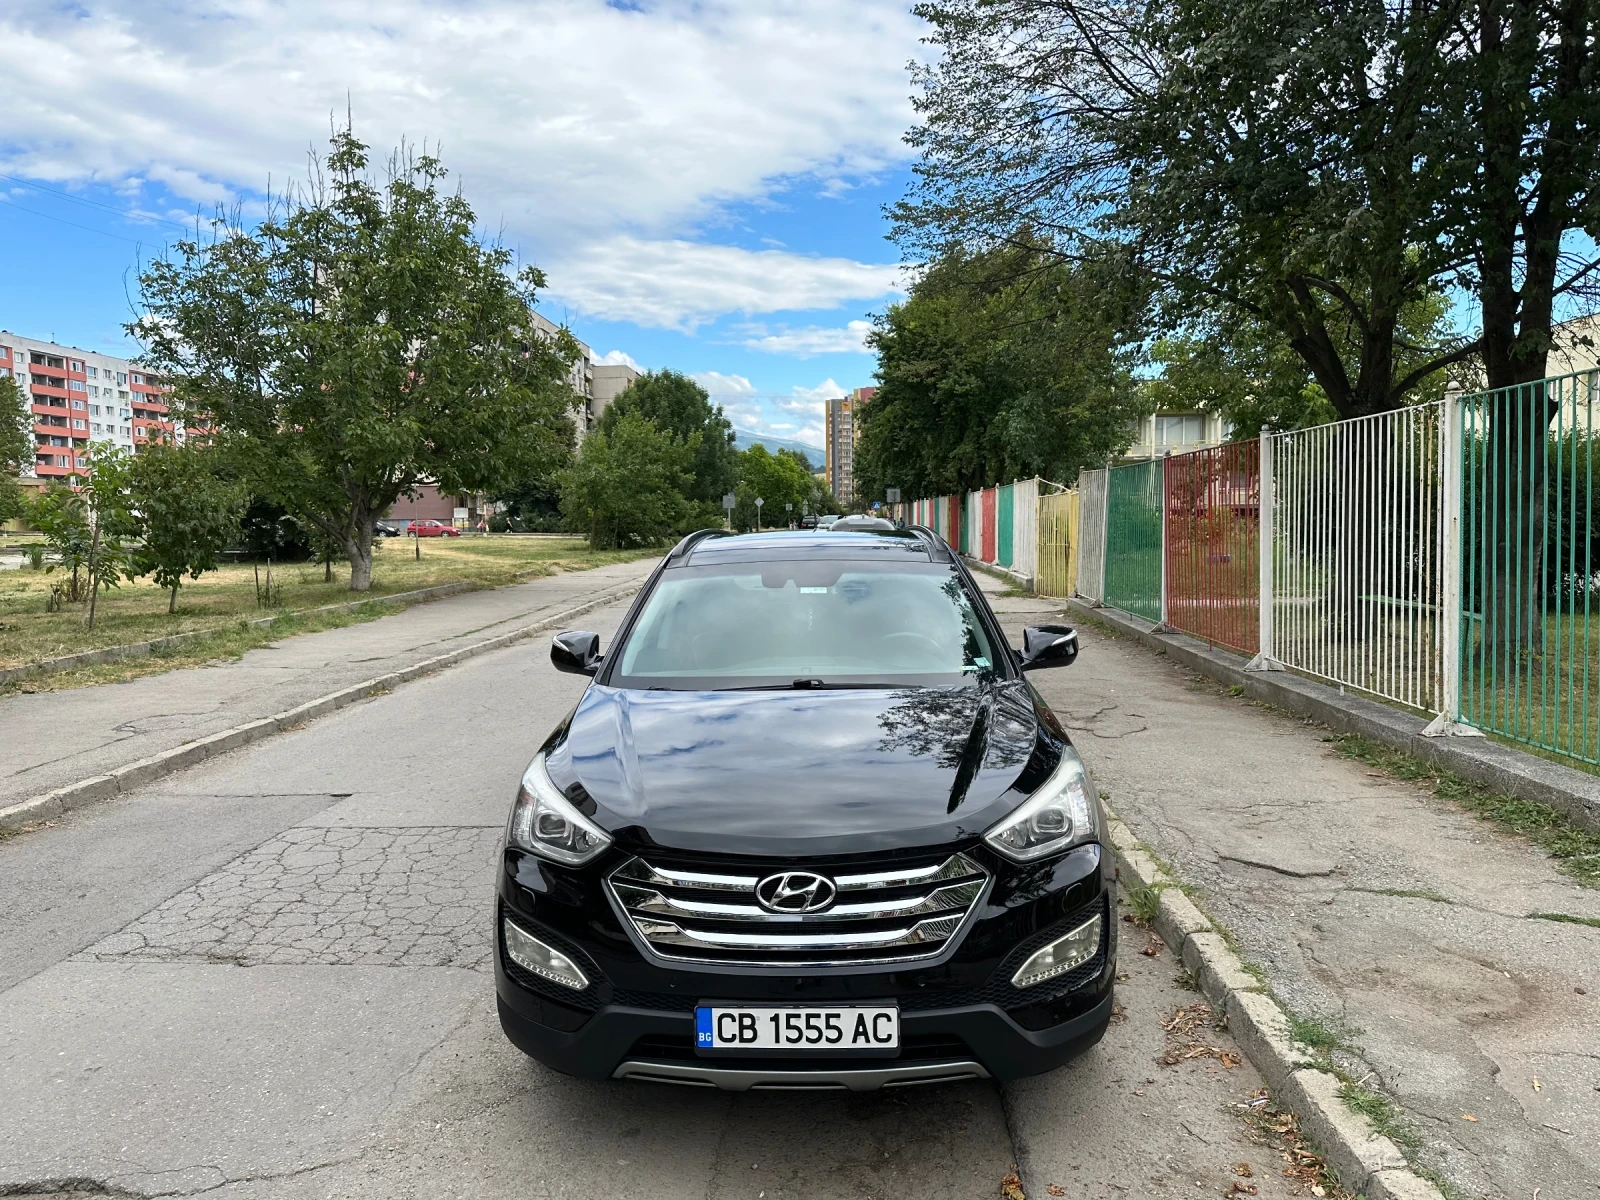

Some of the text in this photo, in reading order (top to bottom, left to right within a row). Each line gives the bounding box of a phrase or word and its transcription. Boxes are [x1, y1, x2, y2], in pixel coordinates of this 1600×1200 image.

[698, 1032, 712, 1042] BG
[717, 1013, 893, 1043] CB 1555 AC
